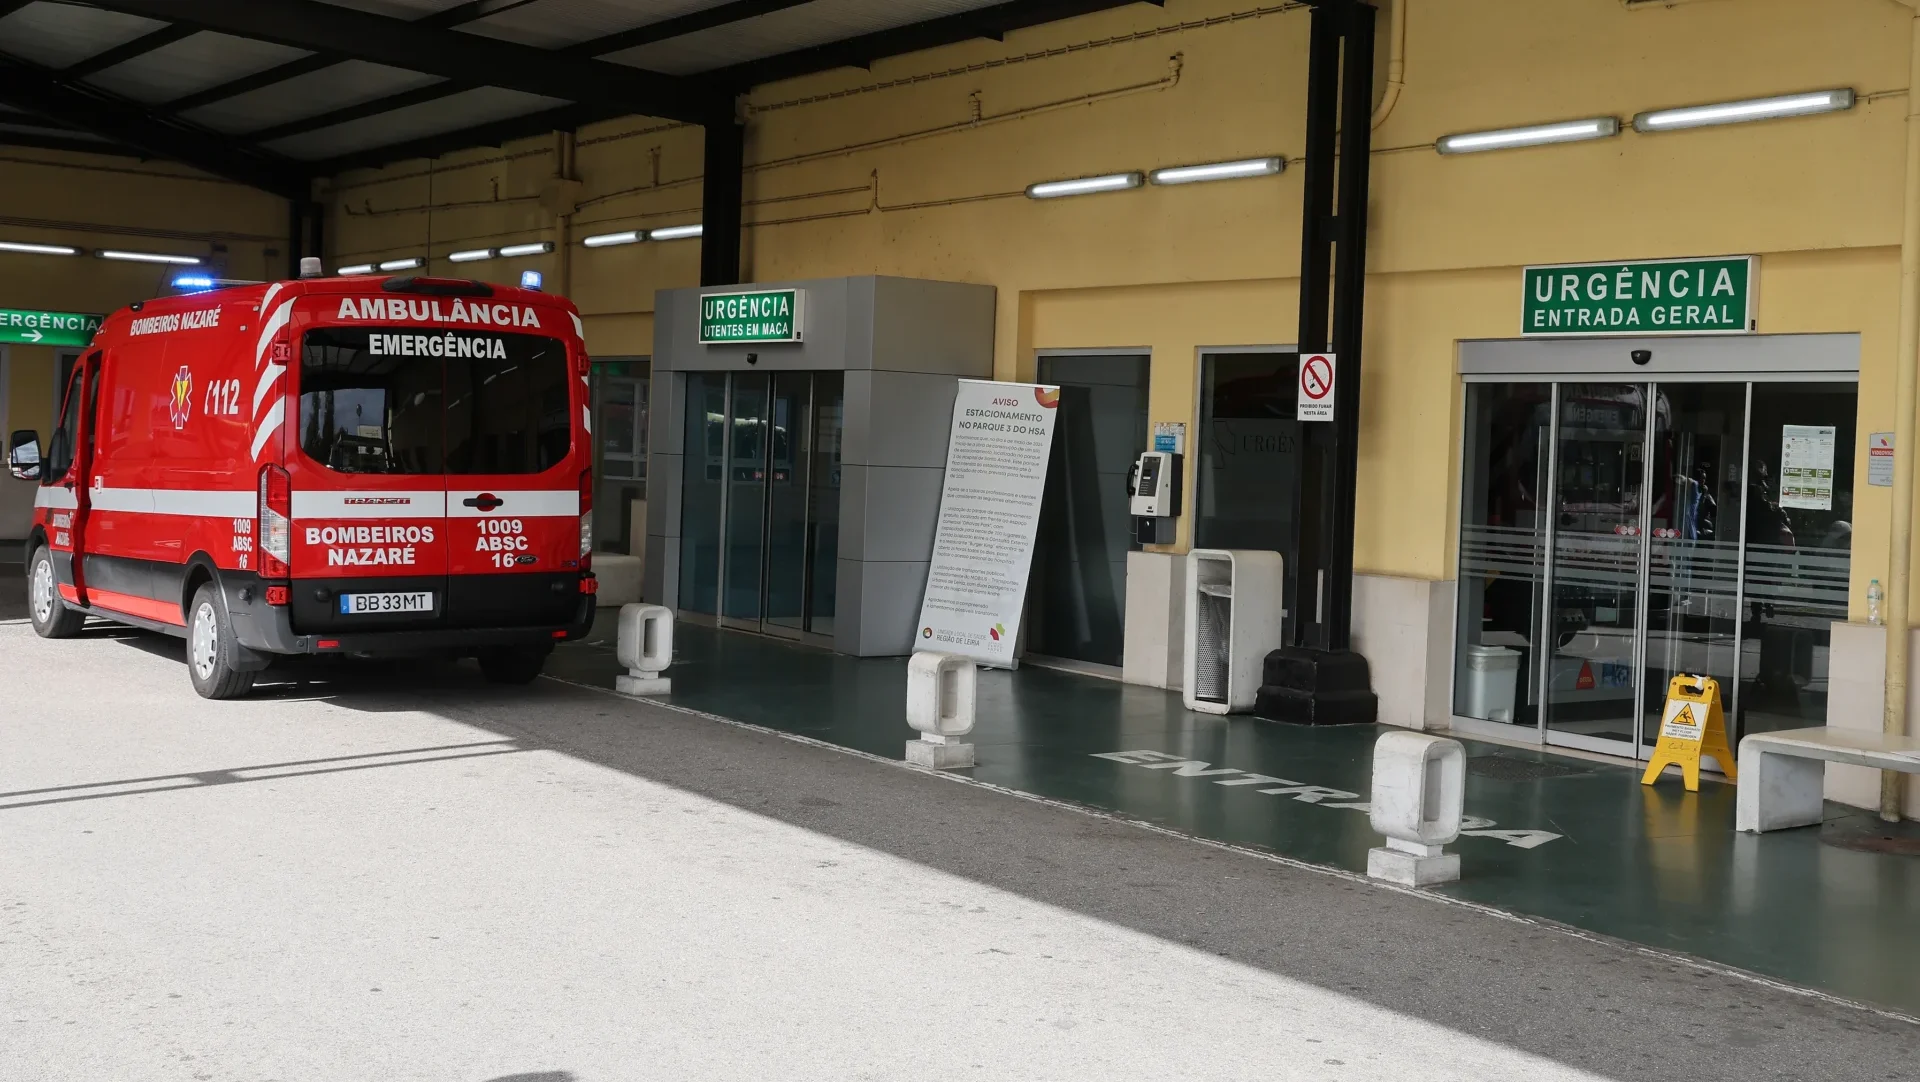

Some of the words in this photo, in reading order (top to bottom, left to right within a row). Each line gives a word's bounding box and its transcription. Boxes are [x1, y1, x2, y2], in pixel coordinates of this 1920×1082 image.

[1535, 267, 1735, 302] URGÊNCIA
[337, 298, 540, 328] AMBULÂNCIA
[706, 296, 788, 320] URGÊNCIA
[1534, 307, 1640, 327] ENTRADA
[1651, 304, 1734, 324] GERAL
[130, 314, 179, 336] BOMBEIROS
[180, 304, 221, 330] NAZARÉ
[704, 324, 744, 337] UTENTES
[746, 324, 759, 336] EM
[762, 322, 788, 335] MACA
[369, 332, 506, 359] EMERGÊNCIA
[212, 378, 240, 414] 112
[991, 397, 1018, 406] AVISO
[965, 408, 1043, 421] ESTACIONAMENTO
[972, 422, 1004, 432] PARQUE
[1028, 427, 1046, 435] HSA
[233, 518, 251, 534] 1009
[476, 519, 523, 535] 1009
[306, 526, 434, 545] BOMBEIROS
[475, 536, 528, 551] ABSC
[233, 536, 252, 552] ABSC
[238, 554, 248, 568] 16
[328, 544, 416, 566] NAZARÉ
[491, 553, 514, 568] 16
[936, 634, 954, 642] REGIÃO
